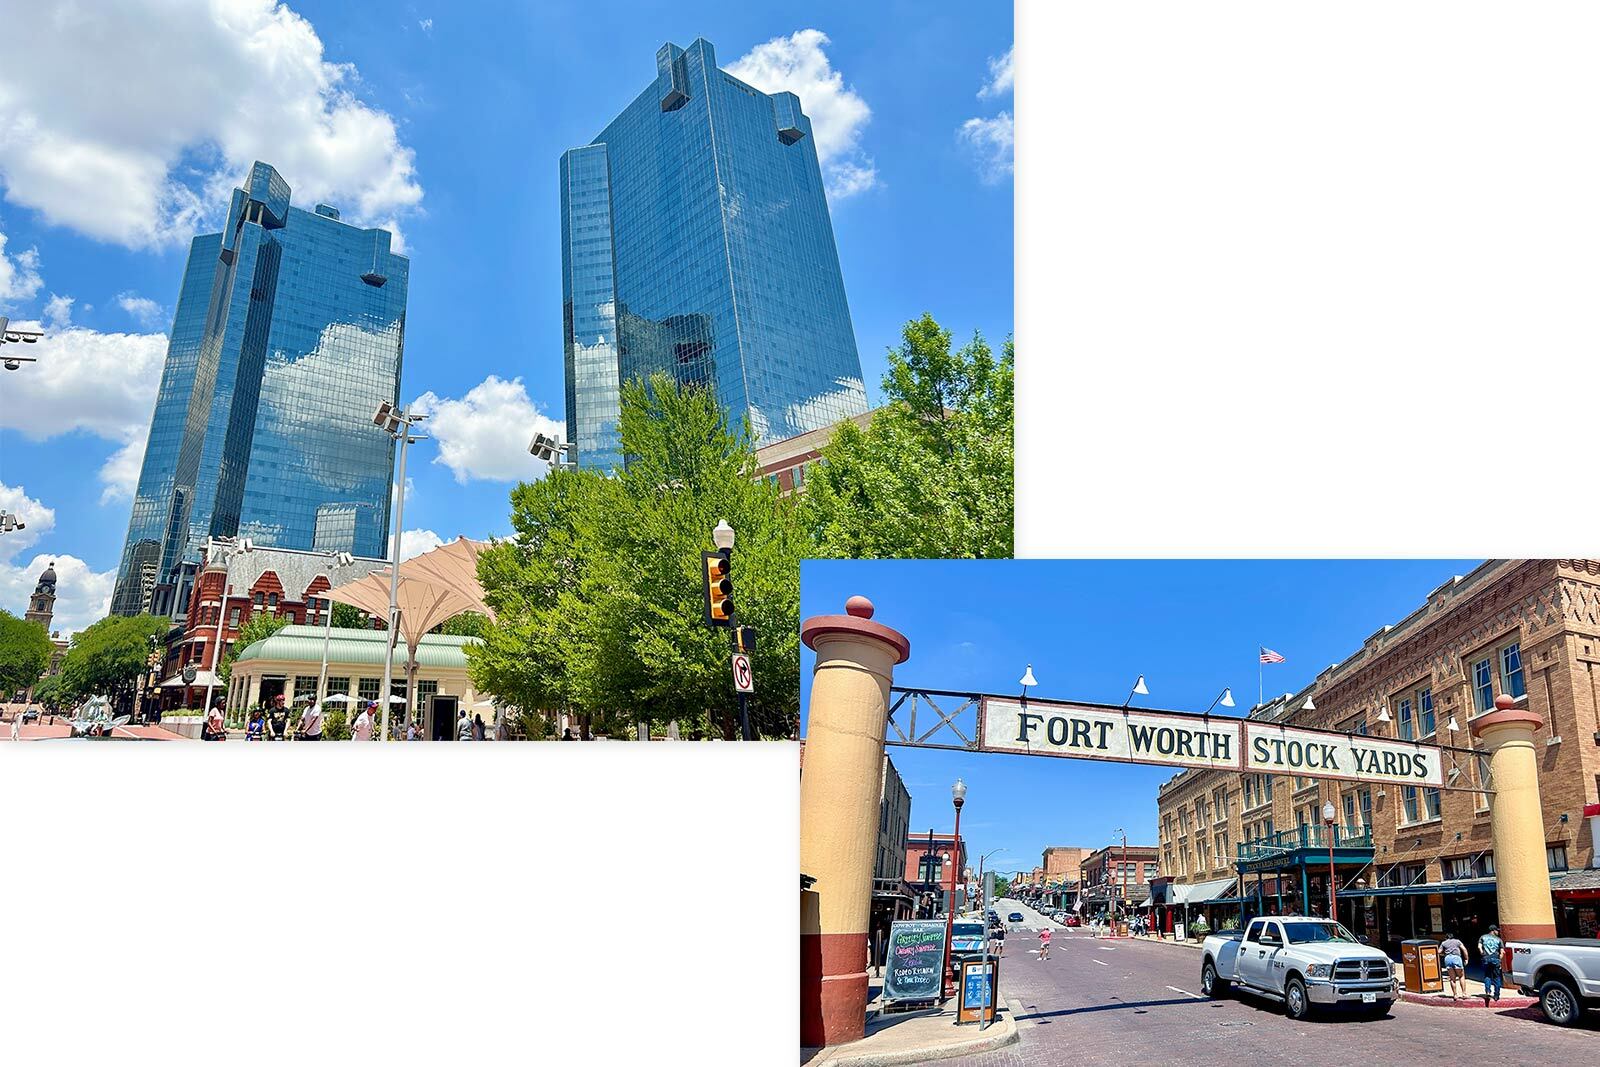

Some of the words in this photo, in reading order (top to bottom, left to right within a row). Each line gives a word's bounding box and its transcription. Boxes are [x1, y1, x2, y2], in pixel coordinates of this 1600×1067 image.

[1015, 713, 1114, 749] FORT
[1127, 724, 1232, 760] WORTH
[1253, 736, 1340, 770] STOCK
[1350, 747, 1428, 778] YARDS
